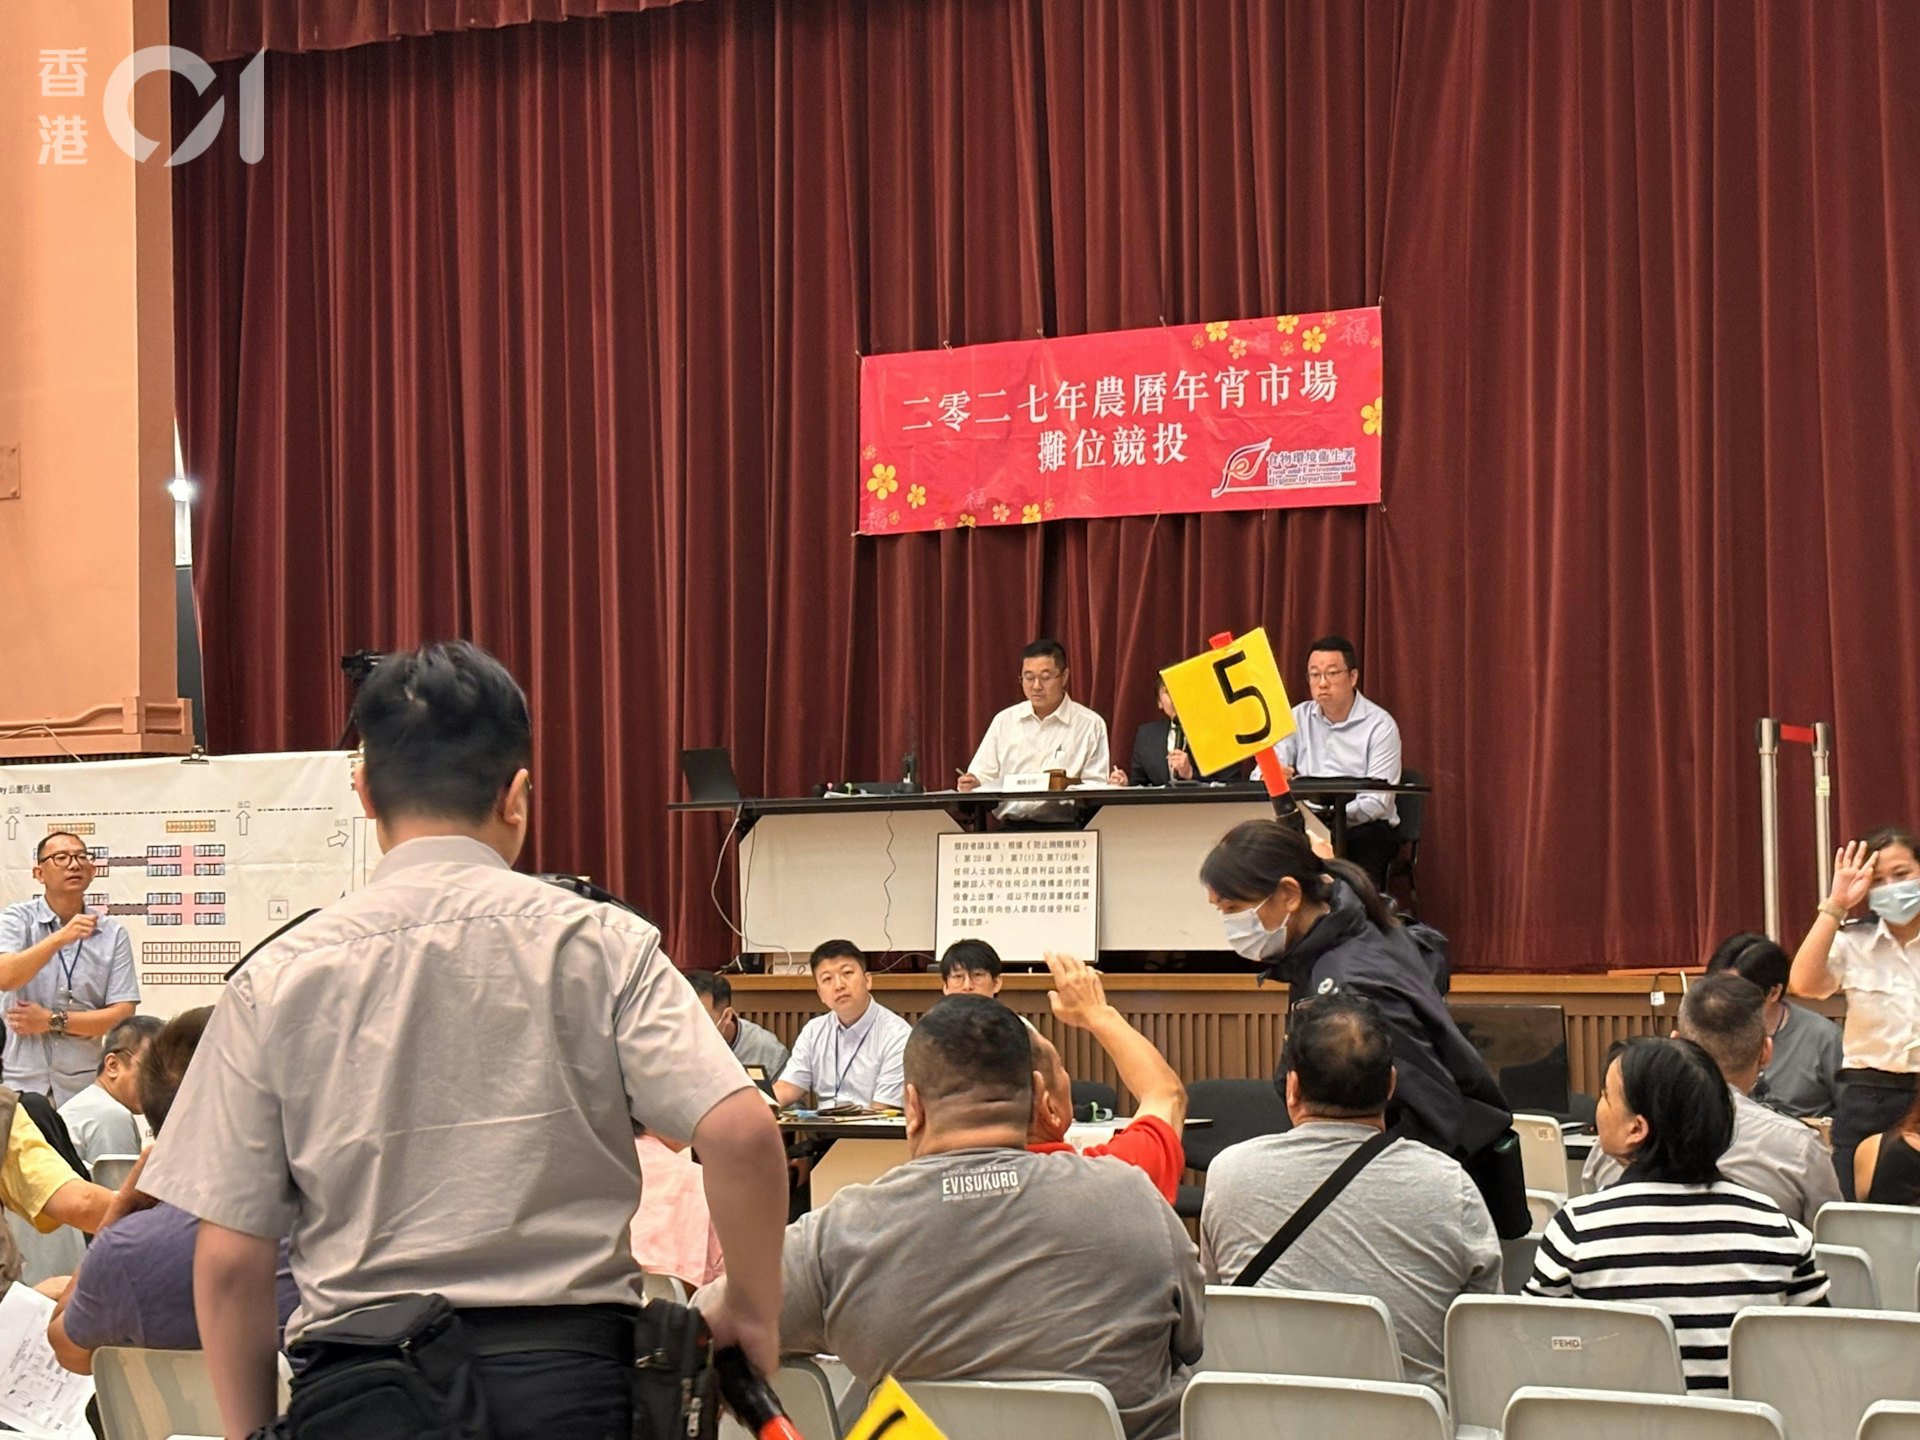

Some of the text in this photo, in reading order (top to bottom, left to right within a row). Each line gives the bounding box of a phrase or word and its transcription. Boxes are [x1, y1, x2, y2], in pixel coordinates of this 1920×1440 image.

[902, 360, 1339, 432] 二零二七年農曆年宵市場
[1037, 422, 1189, 474] 攤位競投
[1268, 448, 1355, 468] 食物環境衛生署
[1288, 466, 1301, 474] and
[1299, 473, 1341, 484] Department
[1213, 650, 1271, 744] 5
[276, 906, 283, 914] A
[942, 1171, 1019, 1195] EVISUKURO
[1552, 1339, 1580, 1348] FEHD
